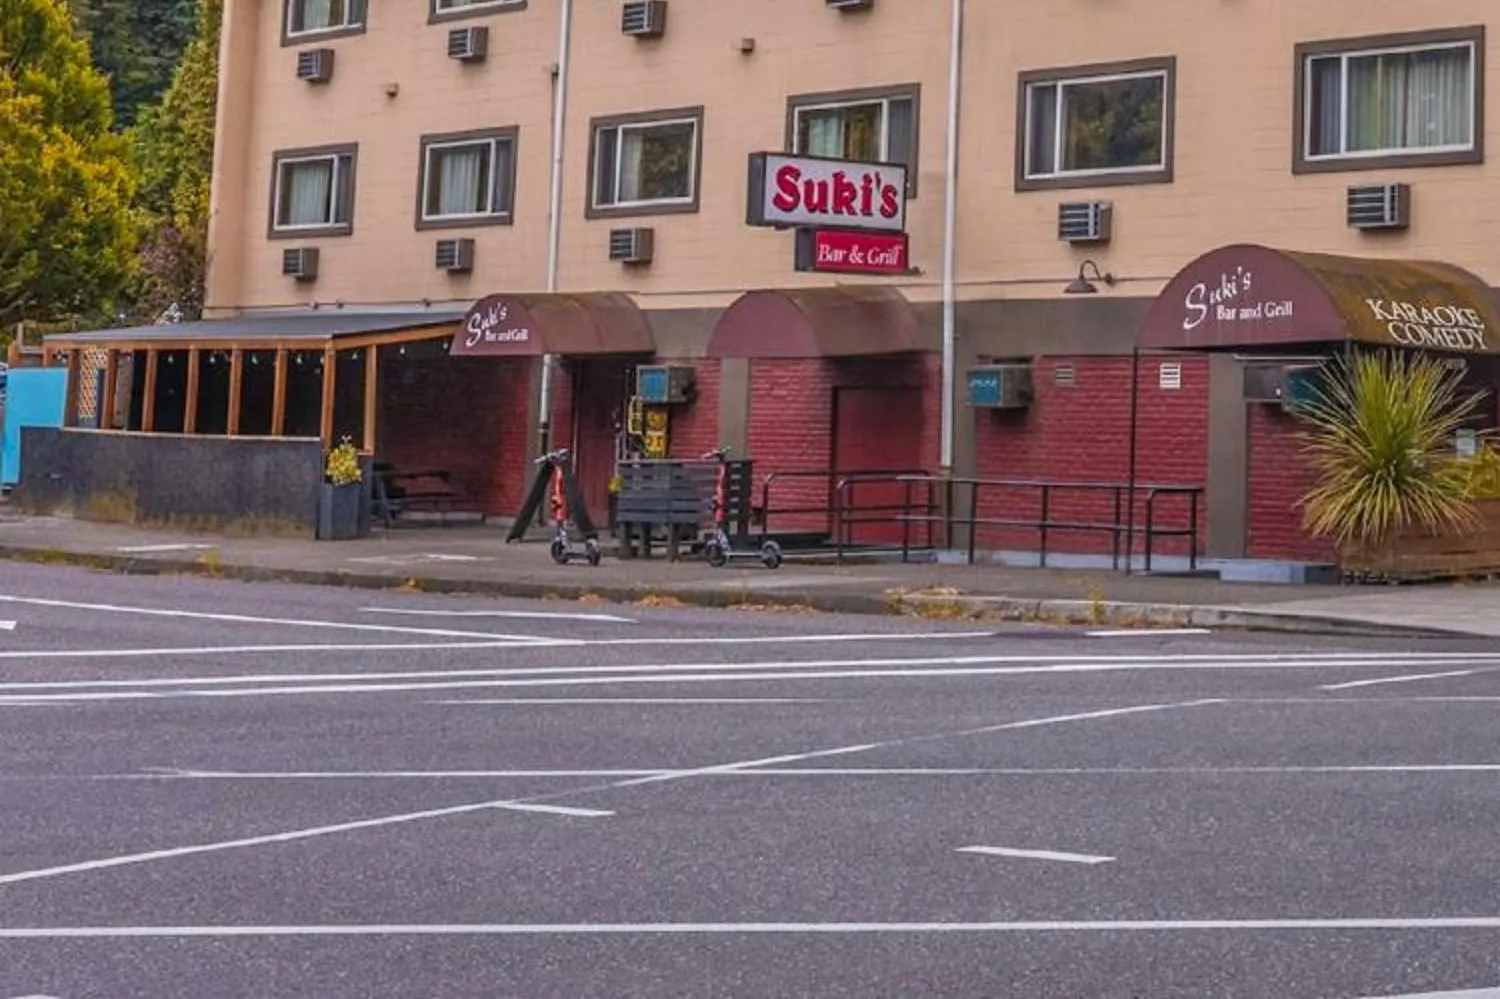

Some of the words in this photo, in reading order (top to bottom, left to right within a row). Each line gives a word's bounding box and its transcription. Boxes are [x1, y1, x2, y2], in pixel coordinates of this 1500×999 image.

[772, 164, 899, 219] Suki's
[818, 244, 847, 262] Bar
[849, 245, 864, 264] &
[867, 246, 904, 266] Grill
[1183, 266, 1252, 330] Suki's
[1216, 305, 1237, 320] Bar
[1239, 302, 1262, 319] and
[1264, 301, 1293, 318] Grill
[1365, 298, 1485, 330] KARAOKE
[465, 302, 508, 348] Suki's
[1387, 321, 1488, 350] COMEDY
